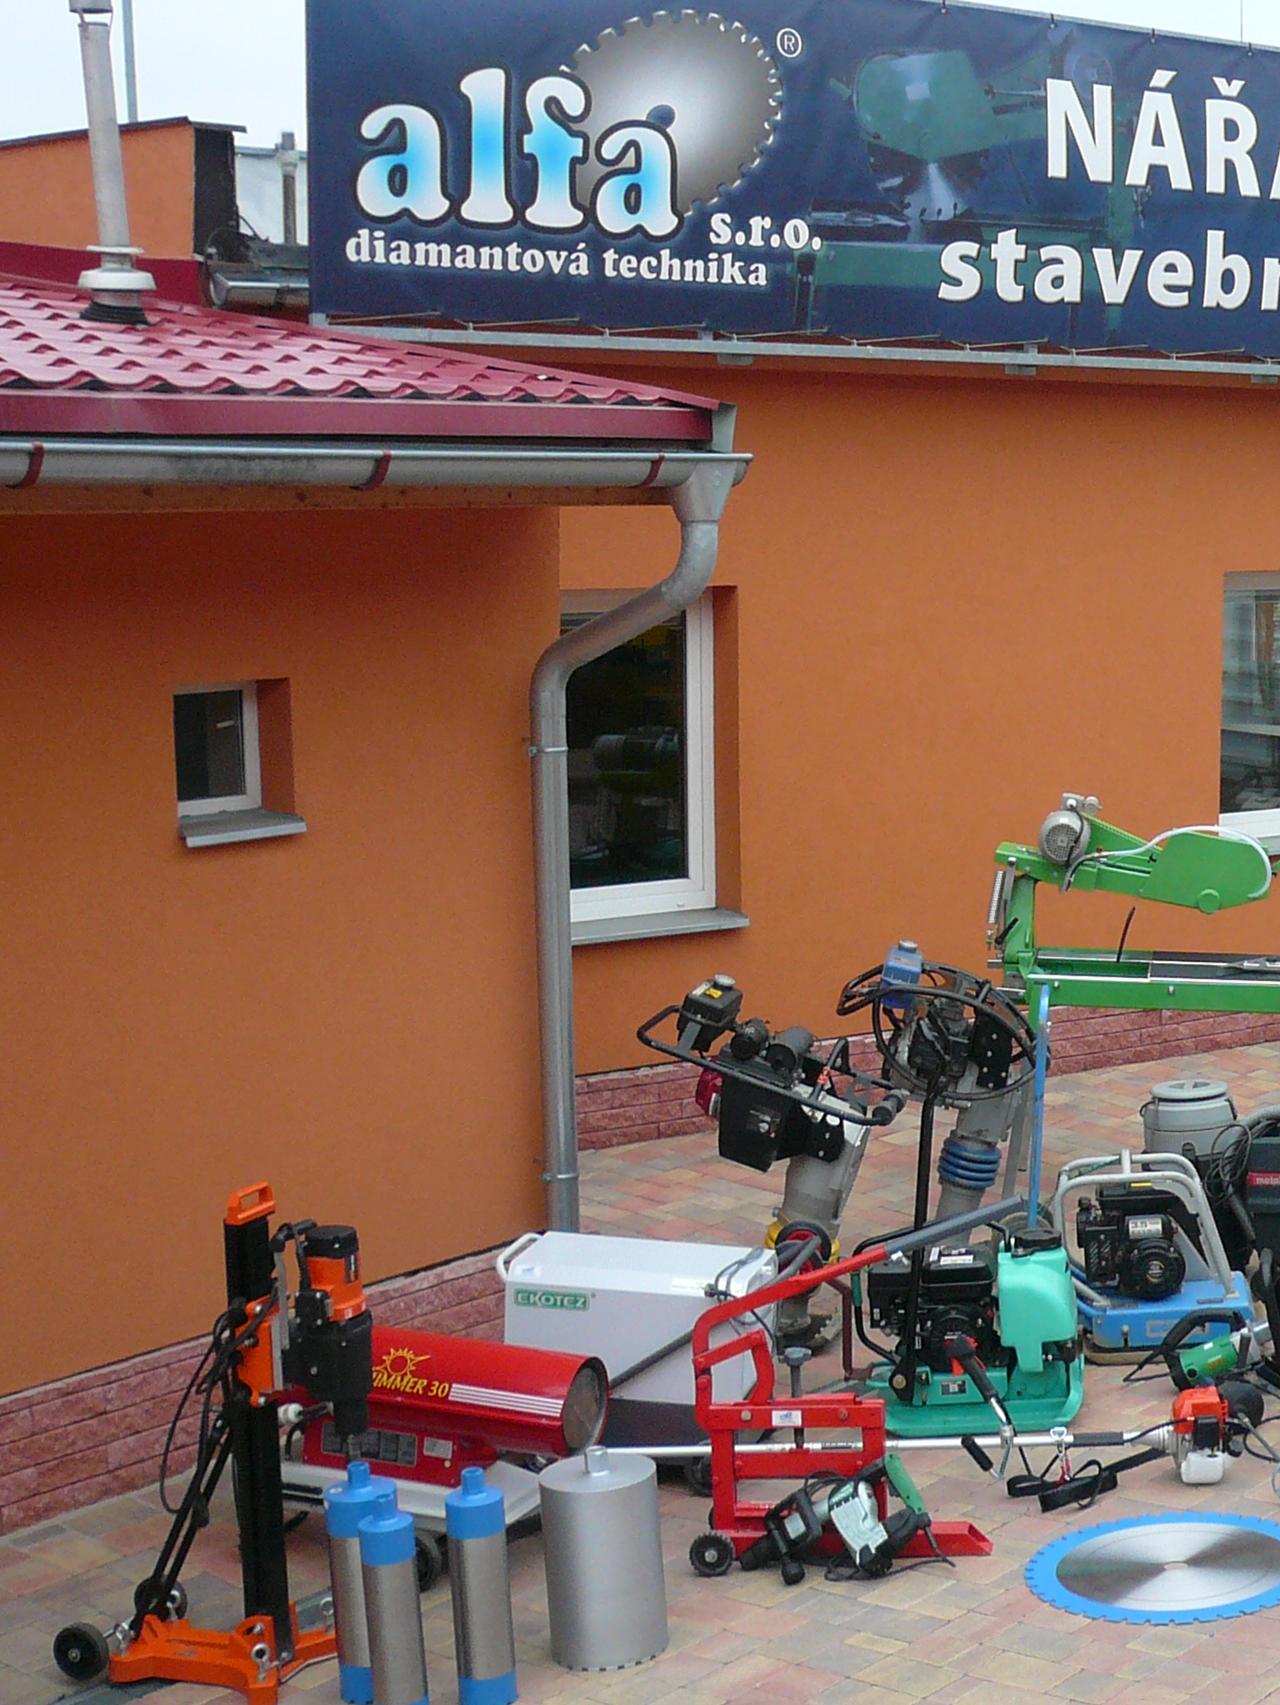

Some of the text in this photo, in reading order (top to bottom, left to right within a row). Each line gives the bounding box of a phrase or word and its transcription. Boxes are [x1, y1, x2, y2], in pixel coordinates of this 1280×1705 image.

[355, 66, 681, 238] alfa
[709, 212, 822, 251] s.r.o.
[345, 228, 768, 286] diamantová technika
[517, 1291, 586, 1309] EKOTEZ
[428, 1380, 450, 1398] 30
